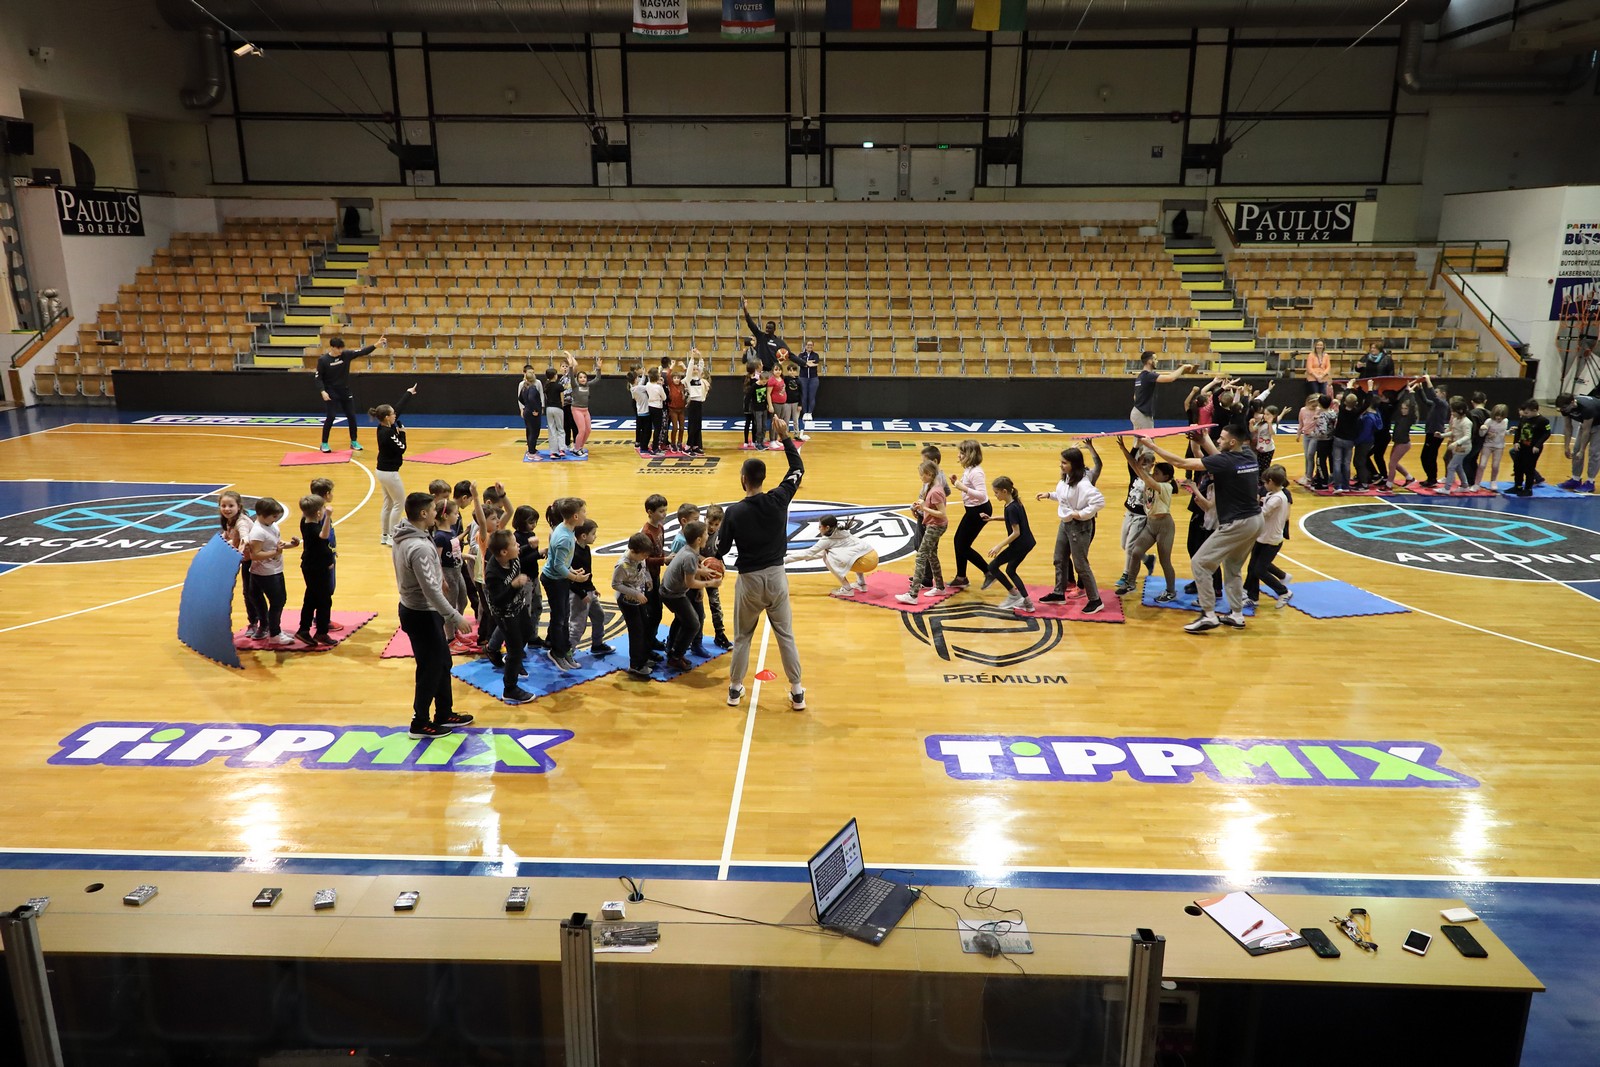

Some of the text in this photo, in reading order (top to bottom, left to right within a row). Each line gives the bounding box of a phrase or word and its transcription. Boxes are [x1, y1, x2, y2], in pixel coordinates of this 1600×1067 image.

[641, 10, 680, 19] BAJNOK
[57, 189, 141, 224] PAULUS
[1238, 203, 1352, 231] PAULUS
[78, 222, 131, 234] BORHÁZ
[1255, 230, 1331, 241] BORHÁZ
[943, 673, 1069, 685] PRÉMIUM
